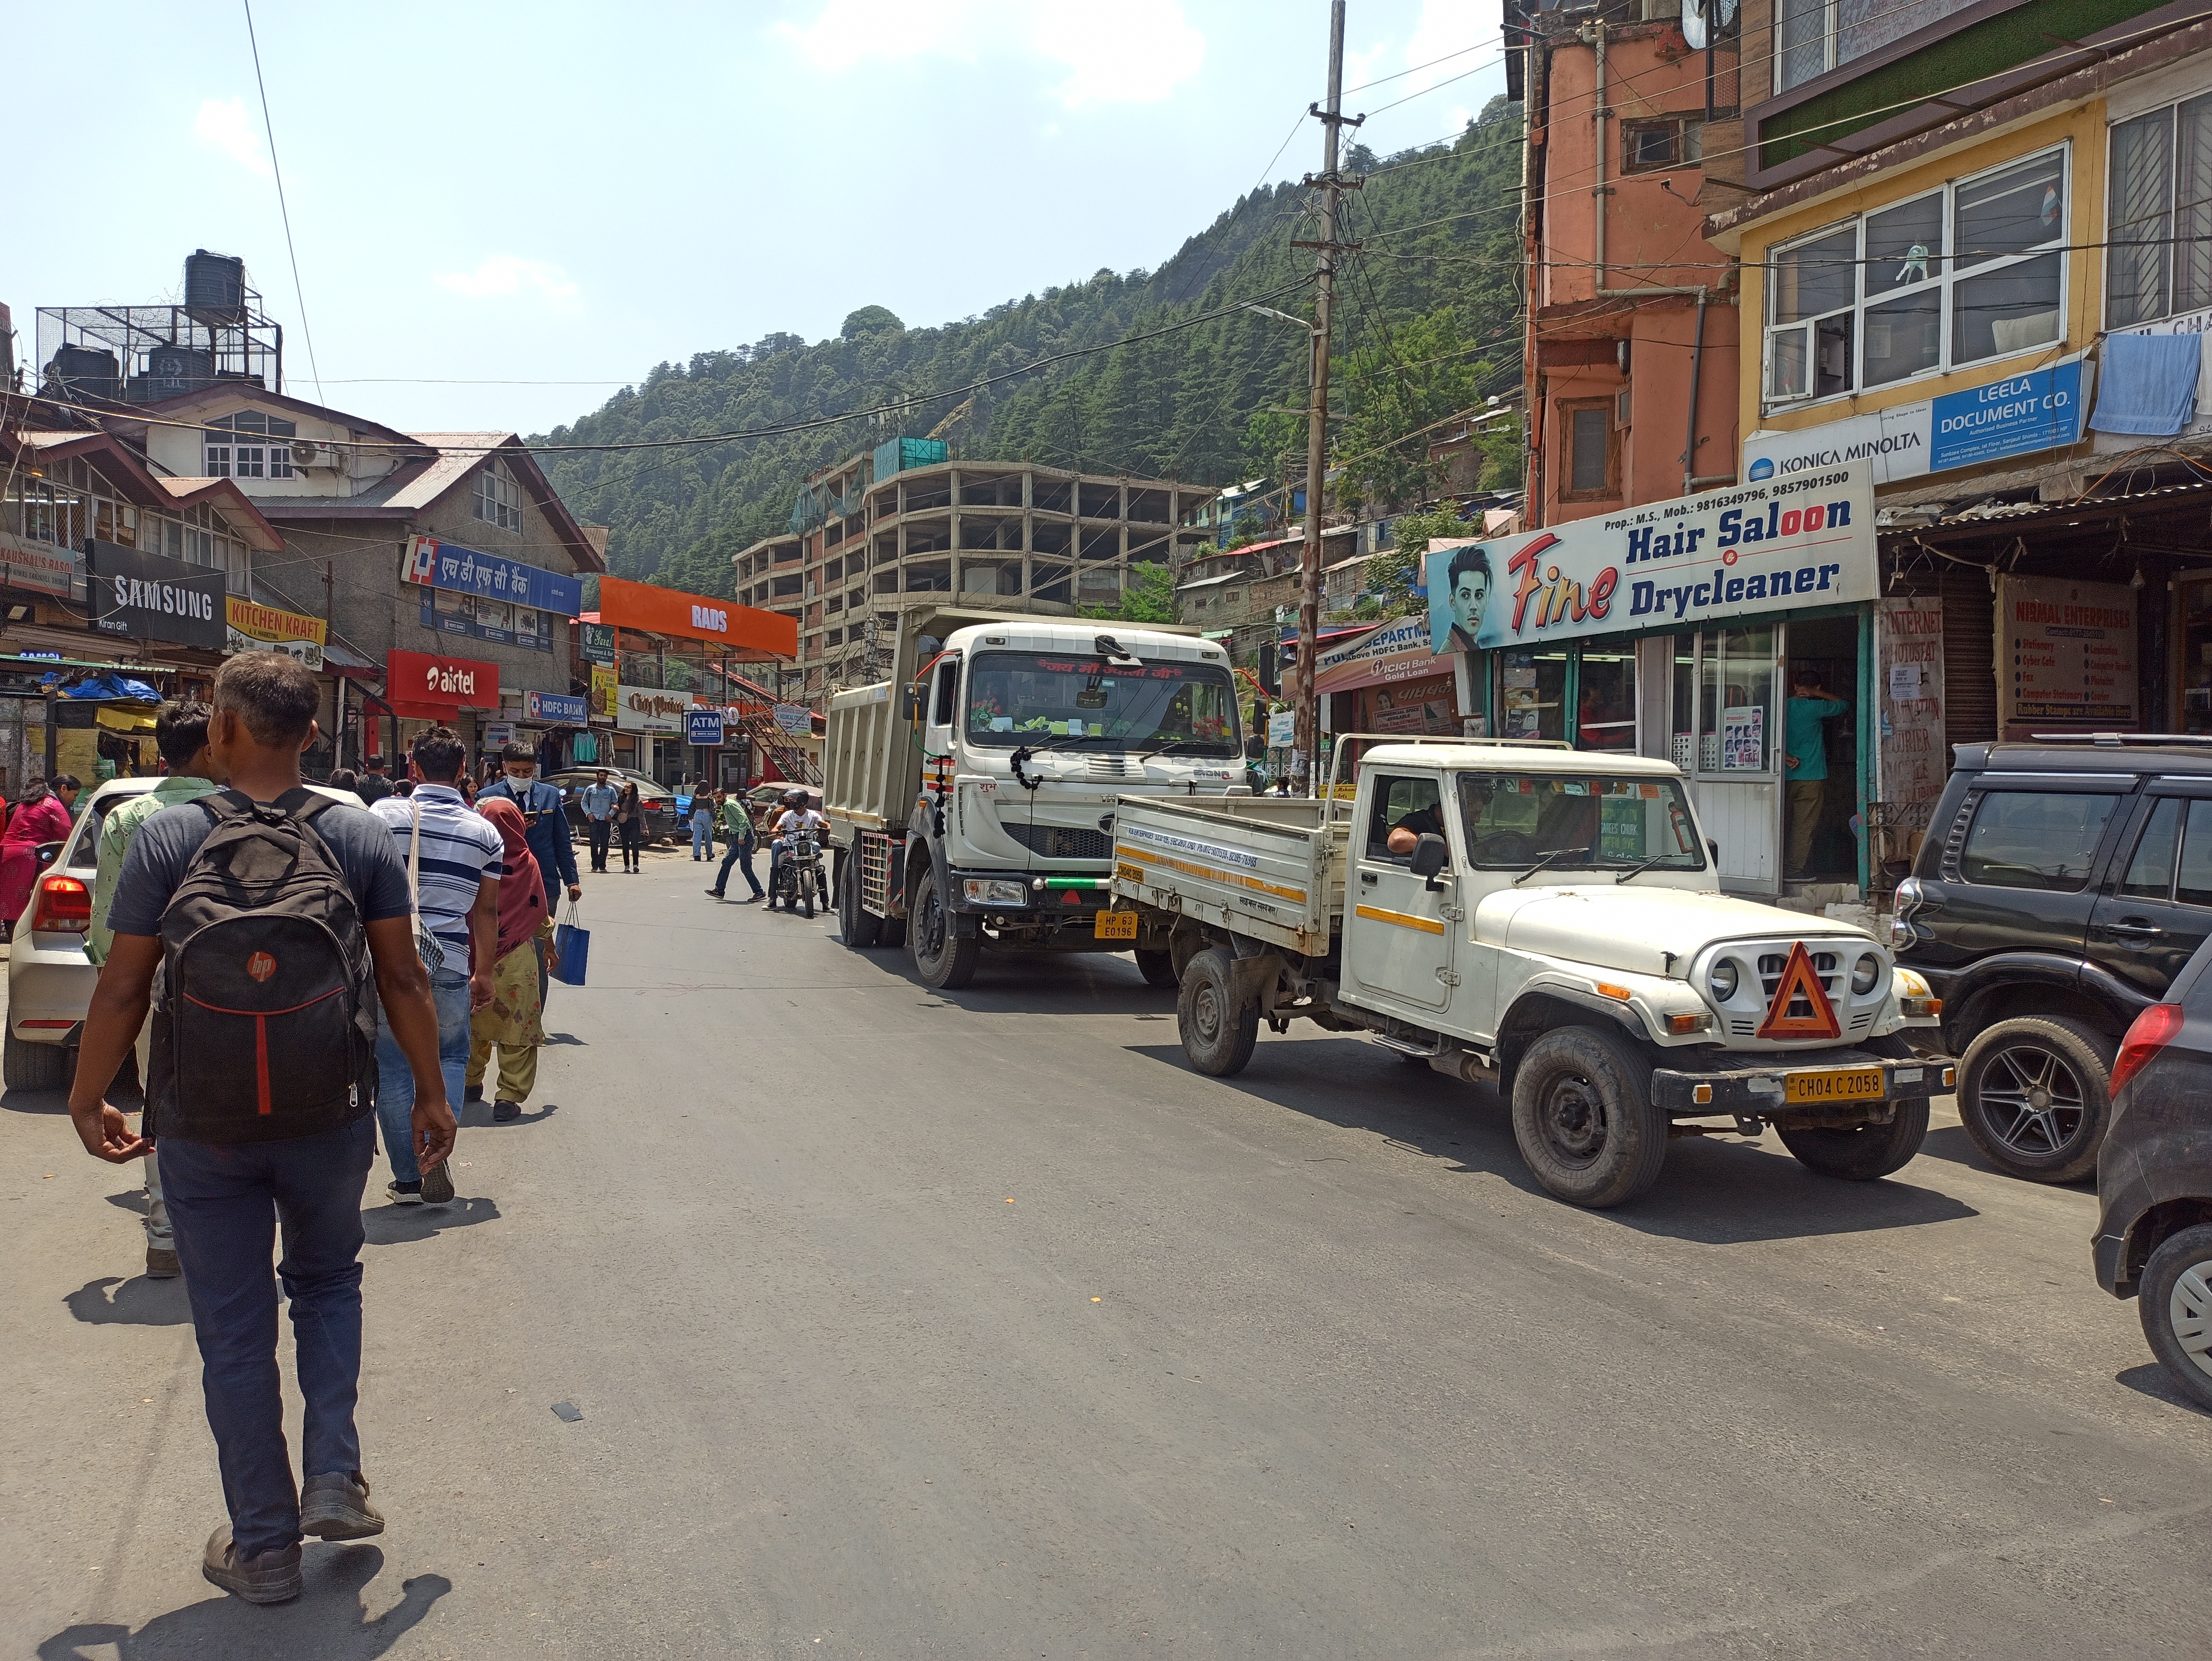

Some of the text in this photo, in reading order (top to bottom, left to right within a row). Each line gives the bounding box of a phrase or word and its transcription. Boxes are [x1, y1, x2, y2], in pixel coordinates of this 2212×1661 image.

[1979, 378, 2031, 403] LEELA
[1941, 391, 2070, 434] DOCUMENT CO.
[1969, 416, 2038, 436] Authorised Business Partner
[1780, 432, 1921, 475] KONICA MINOLTA
[1604, 471, 1849, 531] Prop.: M.S., Mob.: 9816349796, 9857901500
[1626, 499, 1851, 564] Hair Saloon
[442, 554, 528, 594] एच डी एफ सी बैंक
[1508, 532, 1618, 636] Fine
[115, 575, 212, 620] SAMSUNG
[1629, 563, 1839, 619] Drycleaner
[99, 619, 128, 631] Kiran Gift
[232, 602, 320, 640] KITCHEN KRAFT
[691, 605, 727, 633] RADS
[1885, 611, 1942, 635] INTERNET
[2016, 602, 2130, 629] NIRMAL ENTERPRISES
[258, 631, 279, 640] MARKETING
[1346, 652, 1370, 662] Above
[1372, 646, 1395, 656] HDFC
[1397, 642, 1421, 652] Bank,
[1884, 641, 1936, 664] PHOTOSTAT
[2023, 655, 2040, 668] Cyber
[1045, 662, 1075, 673] जय
[1151, 667, 1173, 678] जी
[1384, 656, 1436, 674] ICICI Bank
[1385, 668, 1428, 681] Gold Loan
[441, 665, 475, 695] airtel
[2023, 672, 2034, 682] Fax
[2023, 687, 2051, 701] Computer
[542, 700, 584, 716] HDFC BANK
[2017, 704, 2044, 715] Rubber
[2045, 704, 2071, 717] Stamps
[691, 717, 719, 728] ATM
[979, 783, 997, 793] शुभ
[1105, 927, 1131, 936] E0196
[1106, 916, 1132, 925] HP 63
[252, 952, 272, 982] hp
[1799, 1074, 1879, 1096] CH04 C 2058
